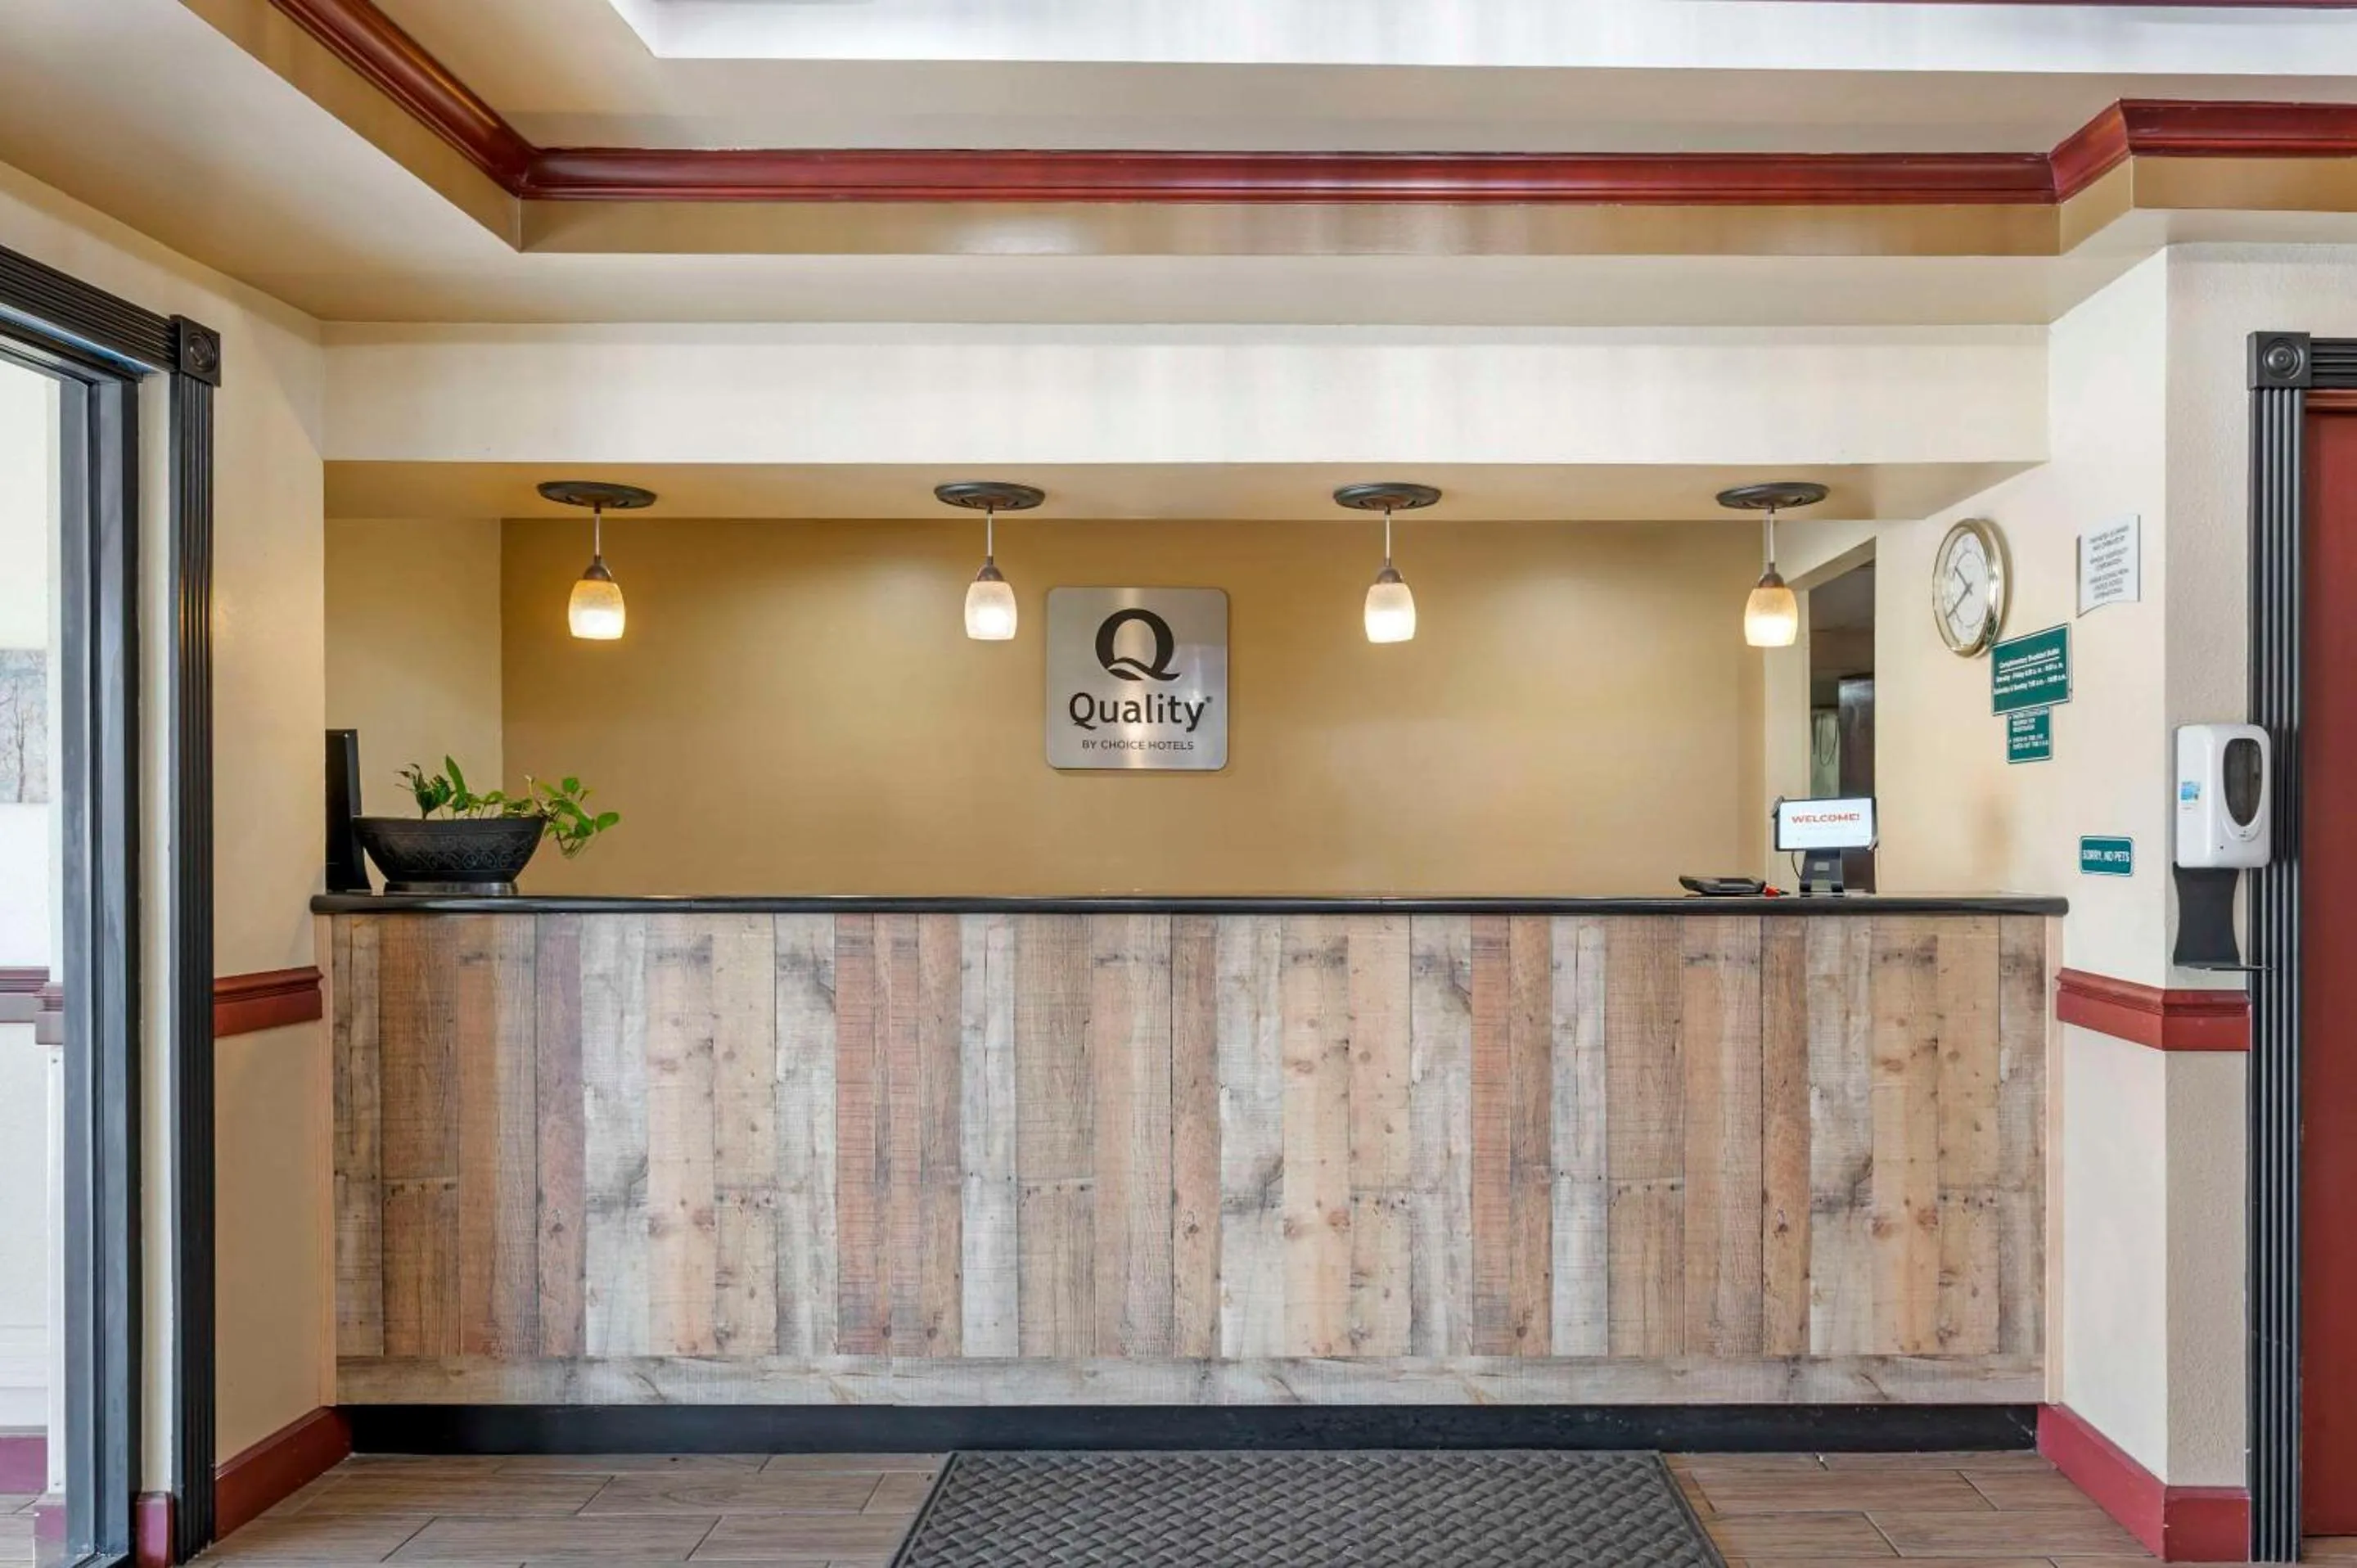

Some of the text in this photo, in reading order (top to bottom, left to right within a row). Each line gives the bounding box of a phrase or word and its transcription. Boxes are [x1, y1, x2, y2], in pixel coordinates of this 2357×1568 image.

[1095, 608, 1181, 681] Q
[1069, 692, 1206, 732] Quality
[1081, 739, 1195, 750] BY CHOICE HOTELS
[1791, 813, 1859, 823] WELCOME!
[2114, 850, 2129, 863] PETS
